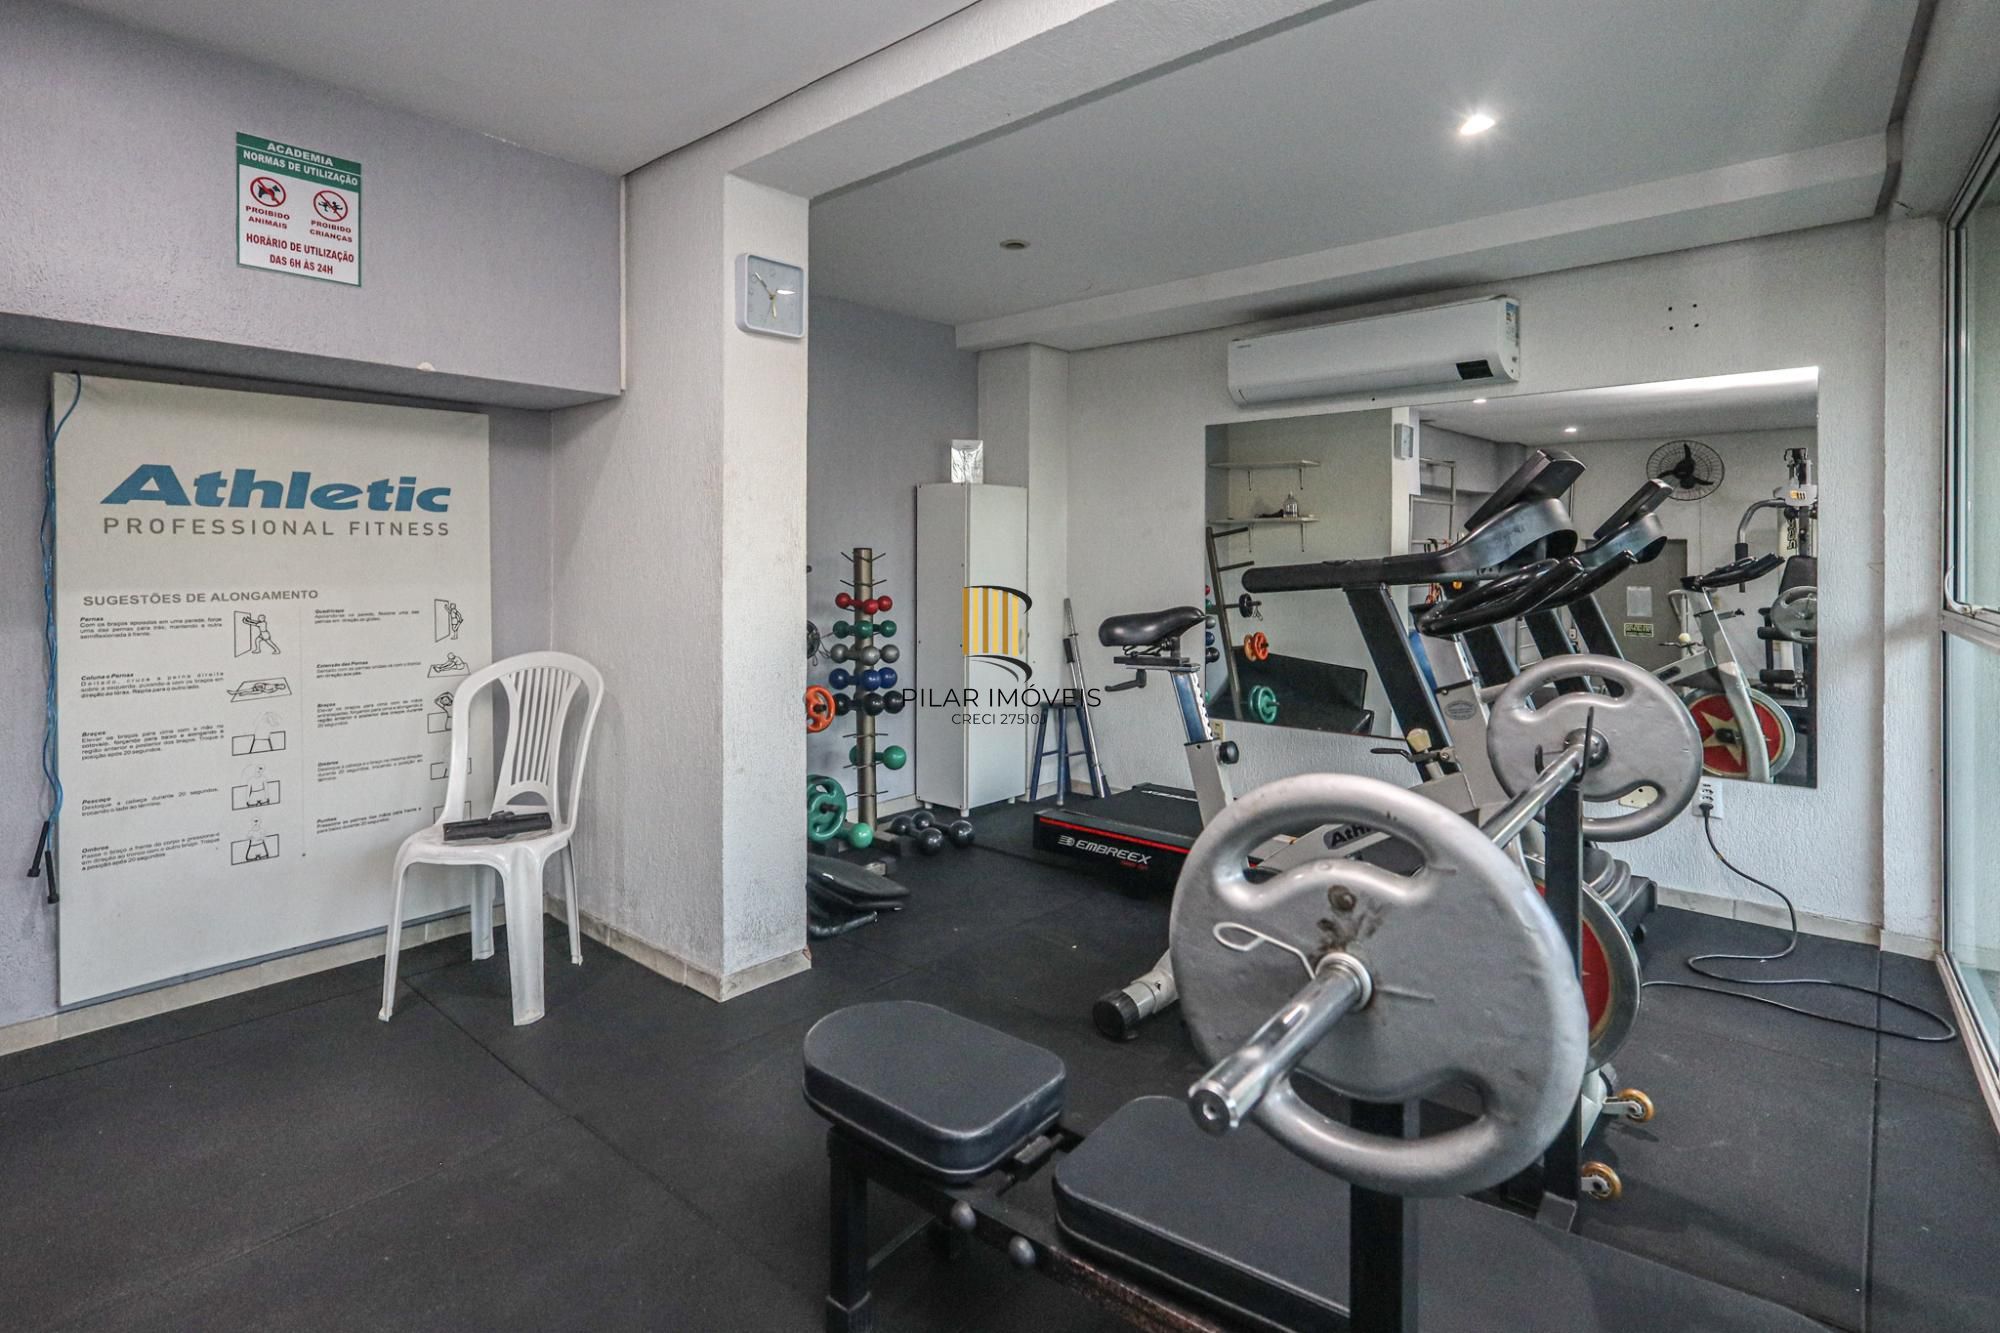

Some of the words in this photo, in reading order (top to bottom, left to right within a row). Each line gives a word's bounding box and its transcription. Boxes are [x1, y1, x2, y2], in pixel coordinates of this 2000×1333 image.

[267, 142, 334, 167] ACADEMIA
[243, 149, 286, 169] NORMAS
[288, 161, 301, 172] DE
[303, 165, 359, 186] UTILIZAÇÃO
[245, 205, 290, 220] PROIBIDO
[248, 215, 288, 229] ANIMAIS
[309, 229, 353, 243] CRIANÇAS
[310, 219, 352, 233] PROIBIDO
[246, 232, 288, 250] HORÁRIO
[290, 242, 302, 253] DE
[304, 244, 355, 263] UTILIZAÇÃO
[269, 253, 287, 266] DAS
[289, 257, 301, 269] 6H
[317, 263, 334, 275] 24H
[100, 463, 452, 513] Athletic
[103, 517, 334, 536] PROFESSIONAL
[349, 521, 449, 537] FITNESS
[83, 592, 182, 607] SUGESTÕES
[186, 592, 206, 604] DE
[210, 589, 319, 602] ALONGAMENTO
[1075, 839, 1152, 865] EMBREEX
